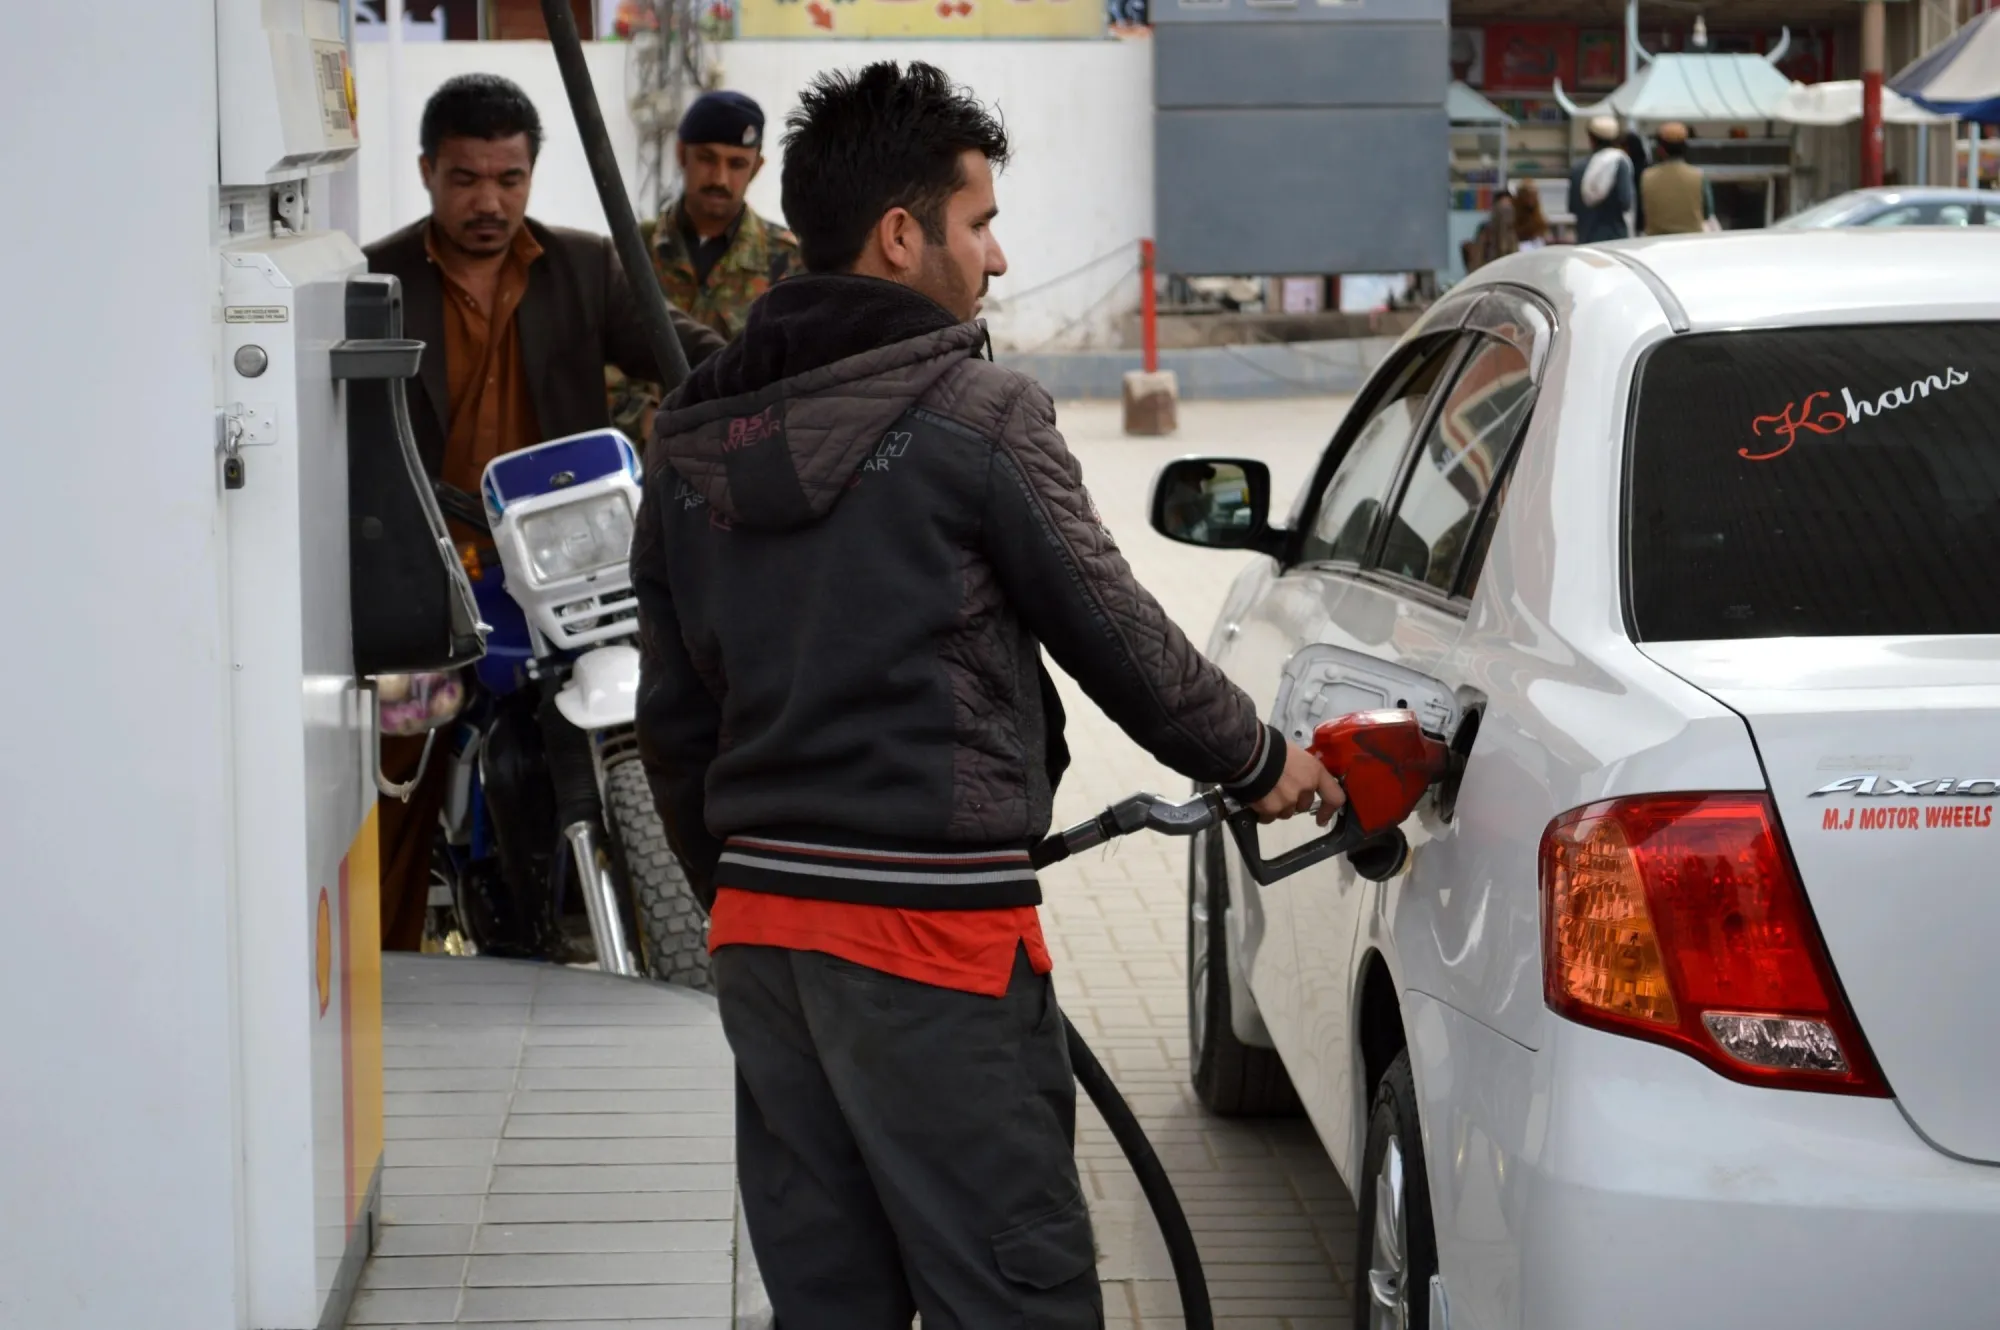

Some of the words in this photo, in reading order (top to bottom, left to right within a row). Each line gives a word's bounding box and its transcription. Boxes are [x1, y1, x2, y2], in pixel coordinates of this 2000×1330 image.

[1737, 367, 1969, 460] Khans
[1822, 807, 1855, 830] M.J
[1859, 806, 1919, 830] MOTOR
[1925, 804, 1993, 829] WHEELS
